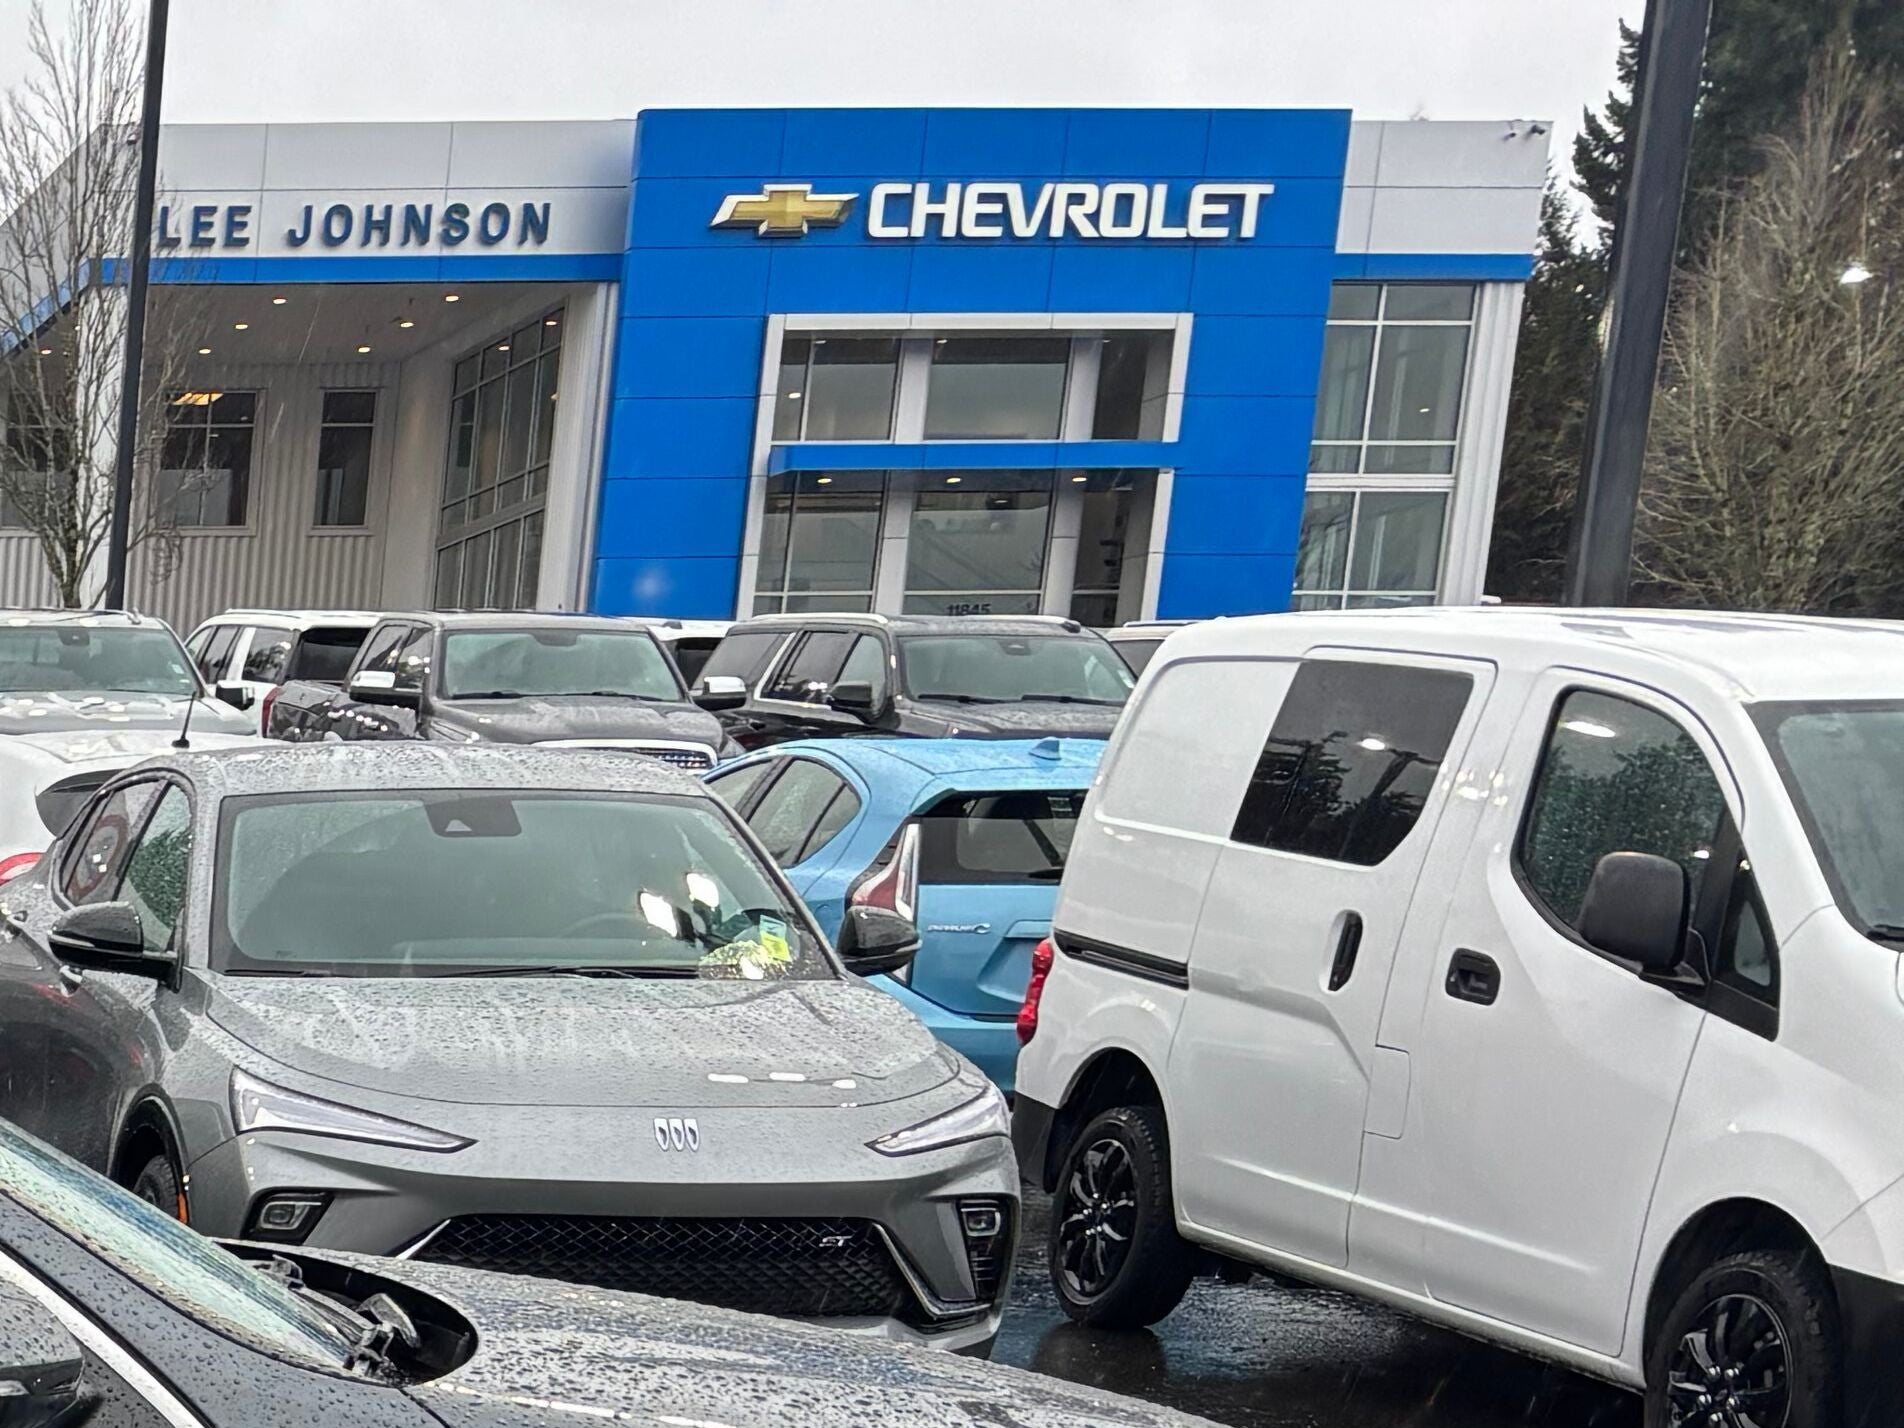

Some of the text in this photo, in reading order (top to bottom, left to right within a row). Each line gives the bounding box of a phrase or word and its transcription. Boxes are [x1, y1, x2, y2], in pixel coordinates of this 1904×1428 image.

[156, 202, 551, 248] LEE JOHNSON
[868, 182, 1275, 239] CHEVROLET
[946, 604, 992, 616] 11845
